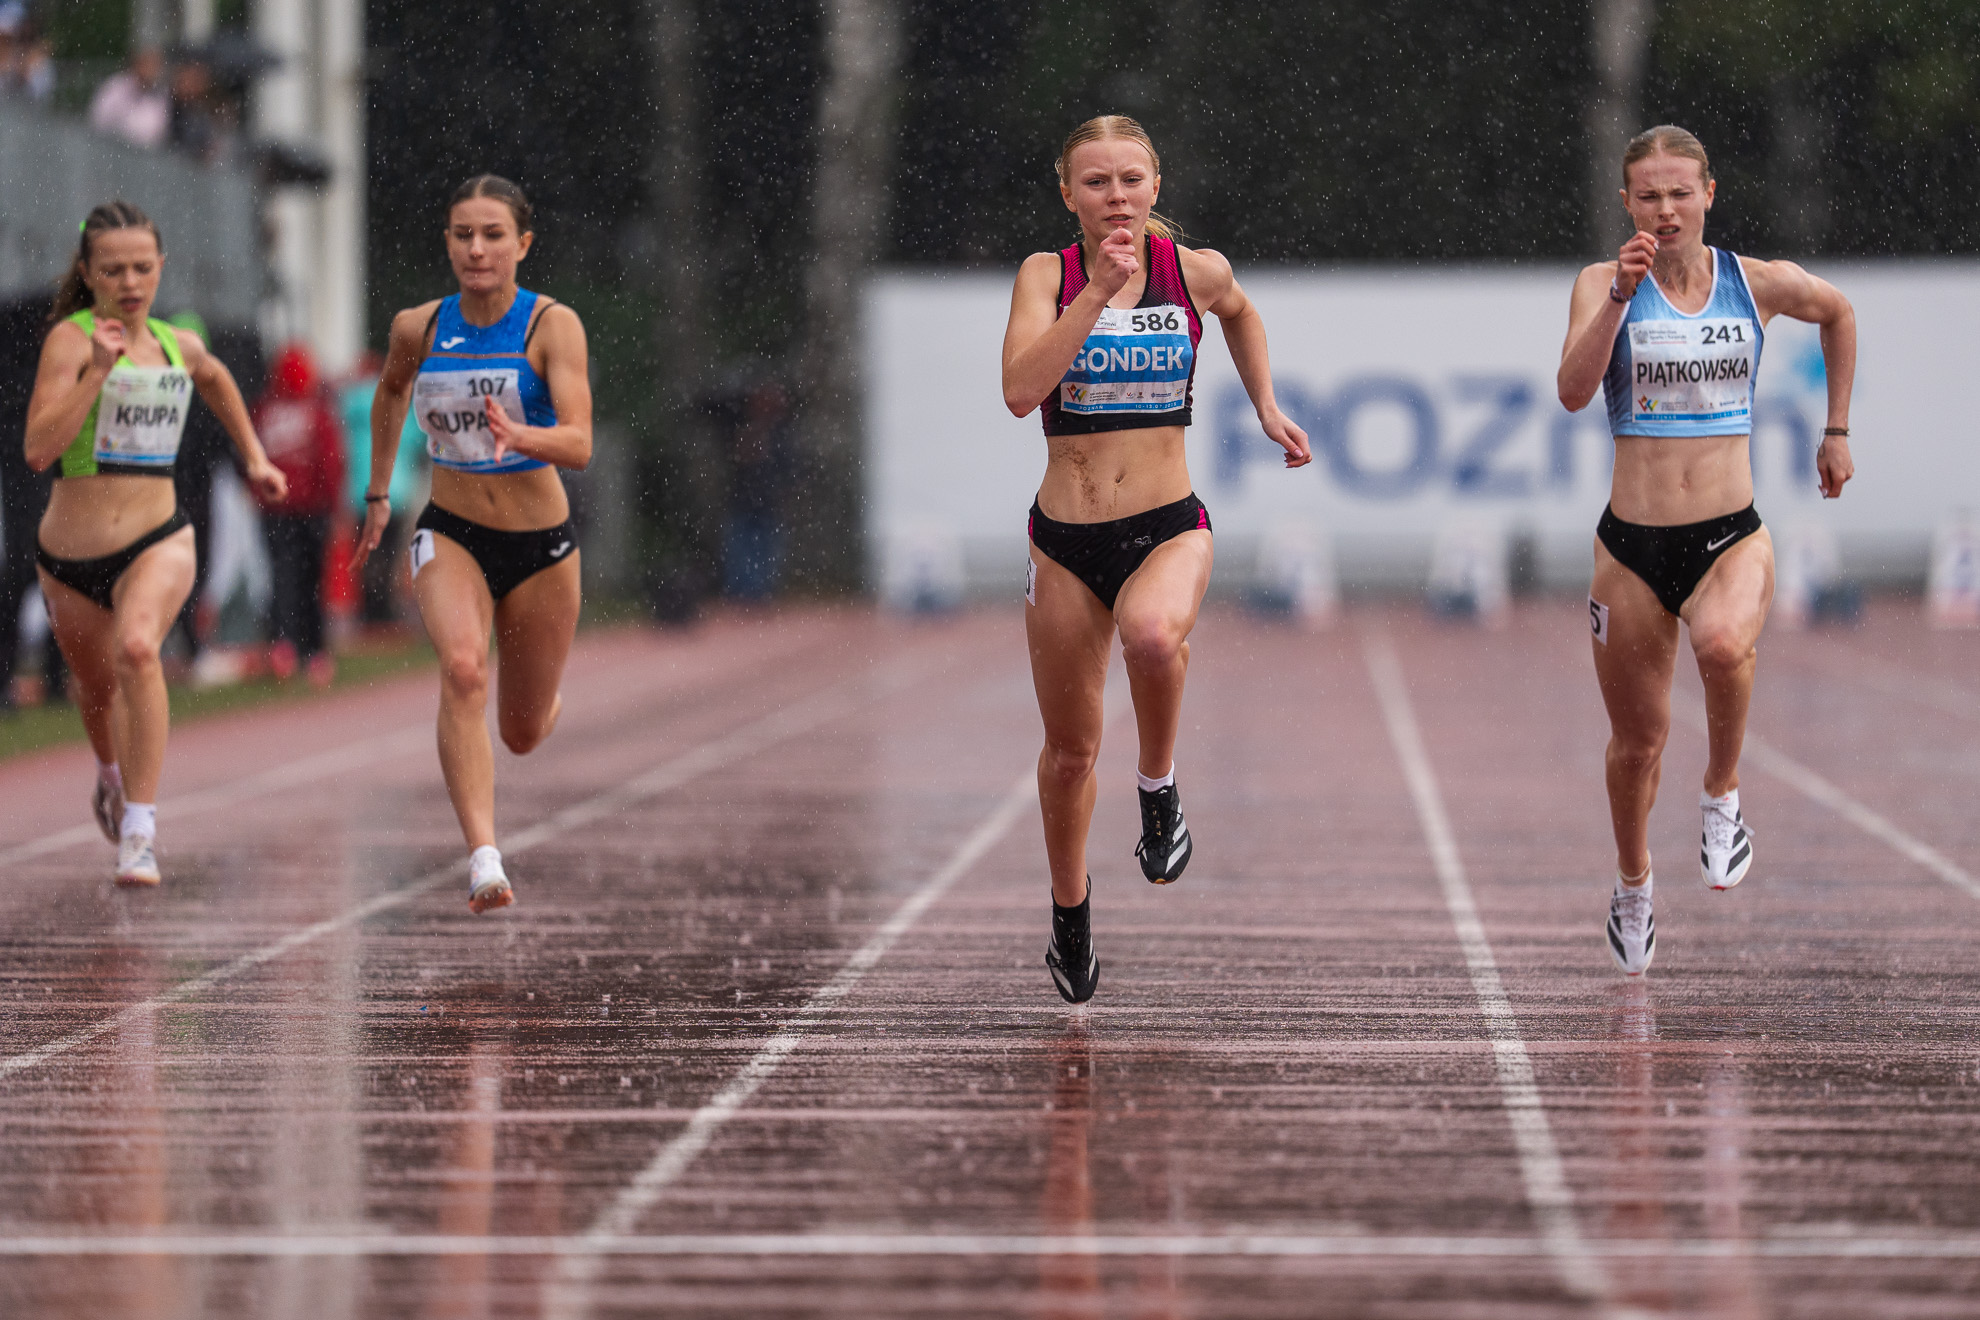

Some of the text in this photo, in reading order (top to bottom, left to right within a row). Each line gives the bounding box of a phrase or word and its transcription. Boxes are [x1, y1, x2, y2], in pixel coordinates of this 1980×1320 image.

[1132, 312, 1179, 332] 586
[1701, 325, 1746, 344] 241
[1070, 346, 1185, 372] GONDEK
[1637, 358, 1748, 387] PIĄTKOWSKA
[468, 377, 507, 397] 107
[116, 404, 179, 426] KRUPA
[411, 534, 423, 567] 7
[1590, 600, 1601, 635] 5
